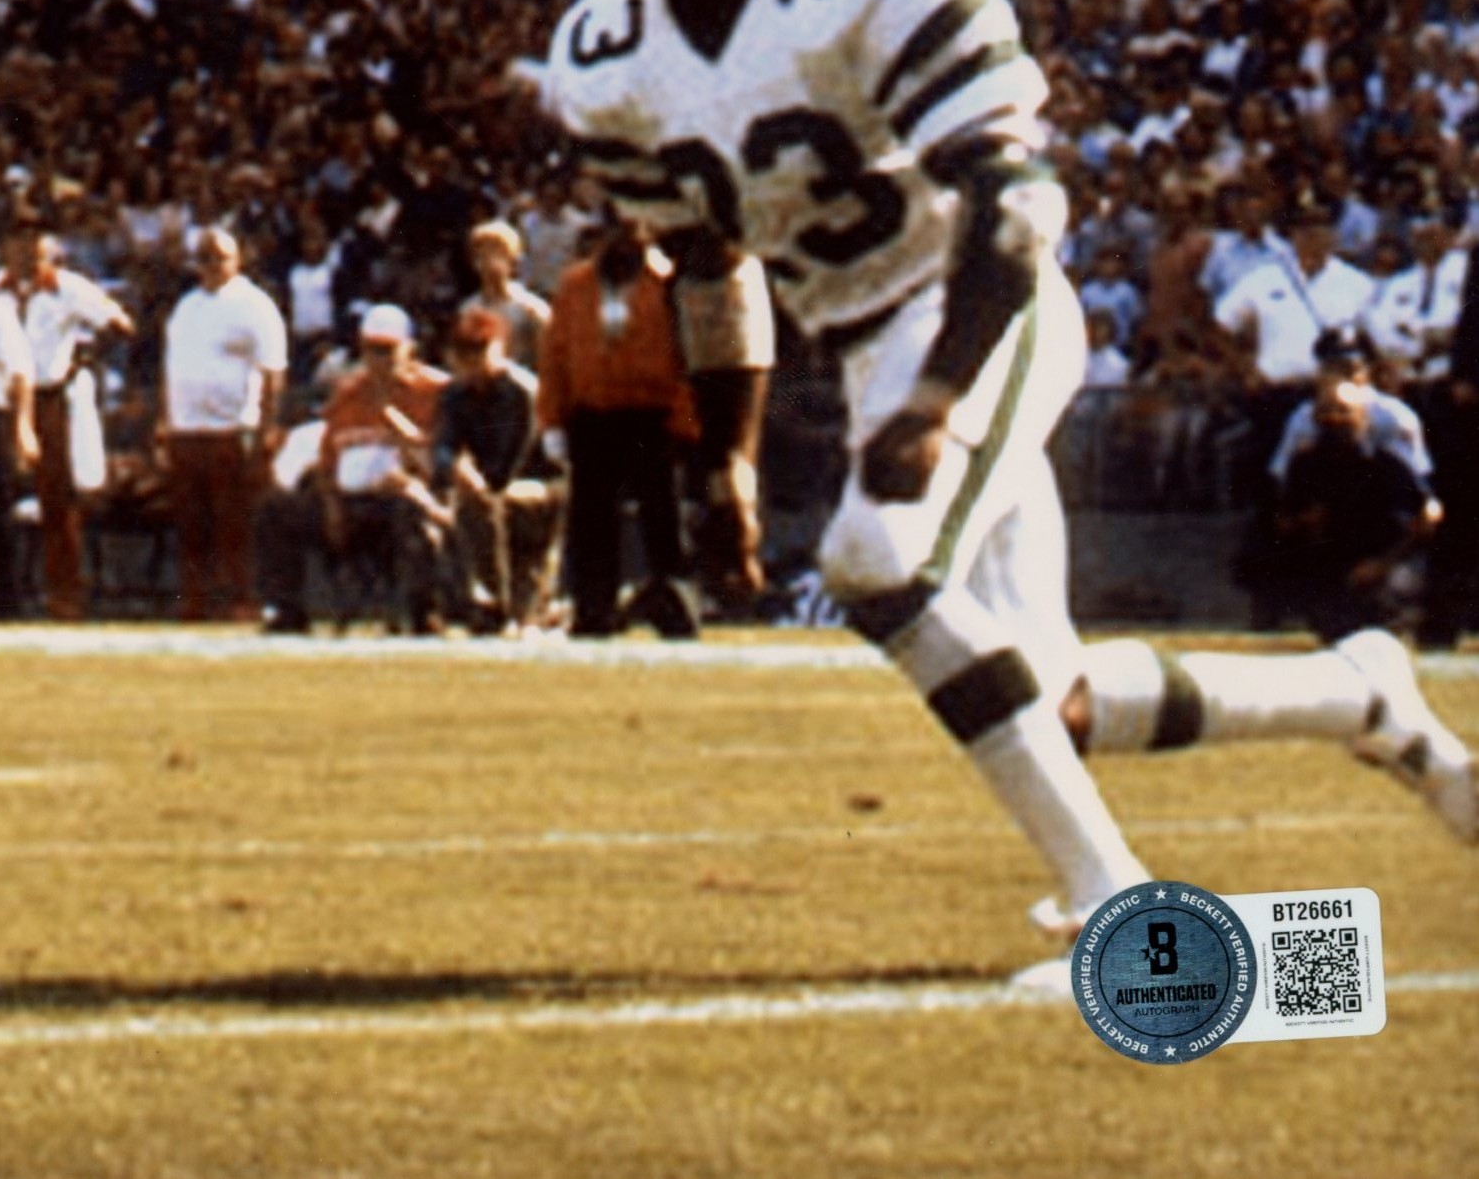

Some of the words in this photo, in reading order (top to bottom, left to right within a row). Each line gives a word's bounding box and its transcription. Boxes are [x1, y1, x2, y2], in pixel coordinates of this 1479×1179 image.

[1084, 894, 1141, 953] AUTHENTIC
[1179, 891, 1233, 932] BECKETT
[1272, 899, 1353, 922] BT26661
[1228, 930, 1249, 992] VERIFIED
[1081, 954, 1101, 1017] VERIFIED
[1116, 982, 1217, 1006] AUTHENTICATED
[1134, 1004, 1201, 1017] AUTOGRAPH
[1188, 994, 1245, 1053] AUTHENTIC
[1096, 1016, 1149, 1055] BECKETT
